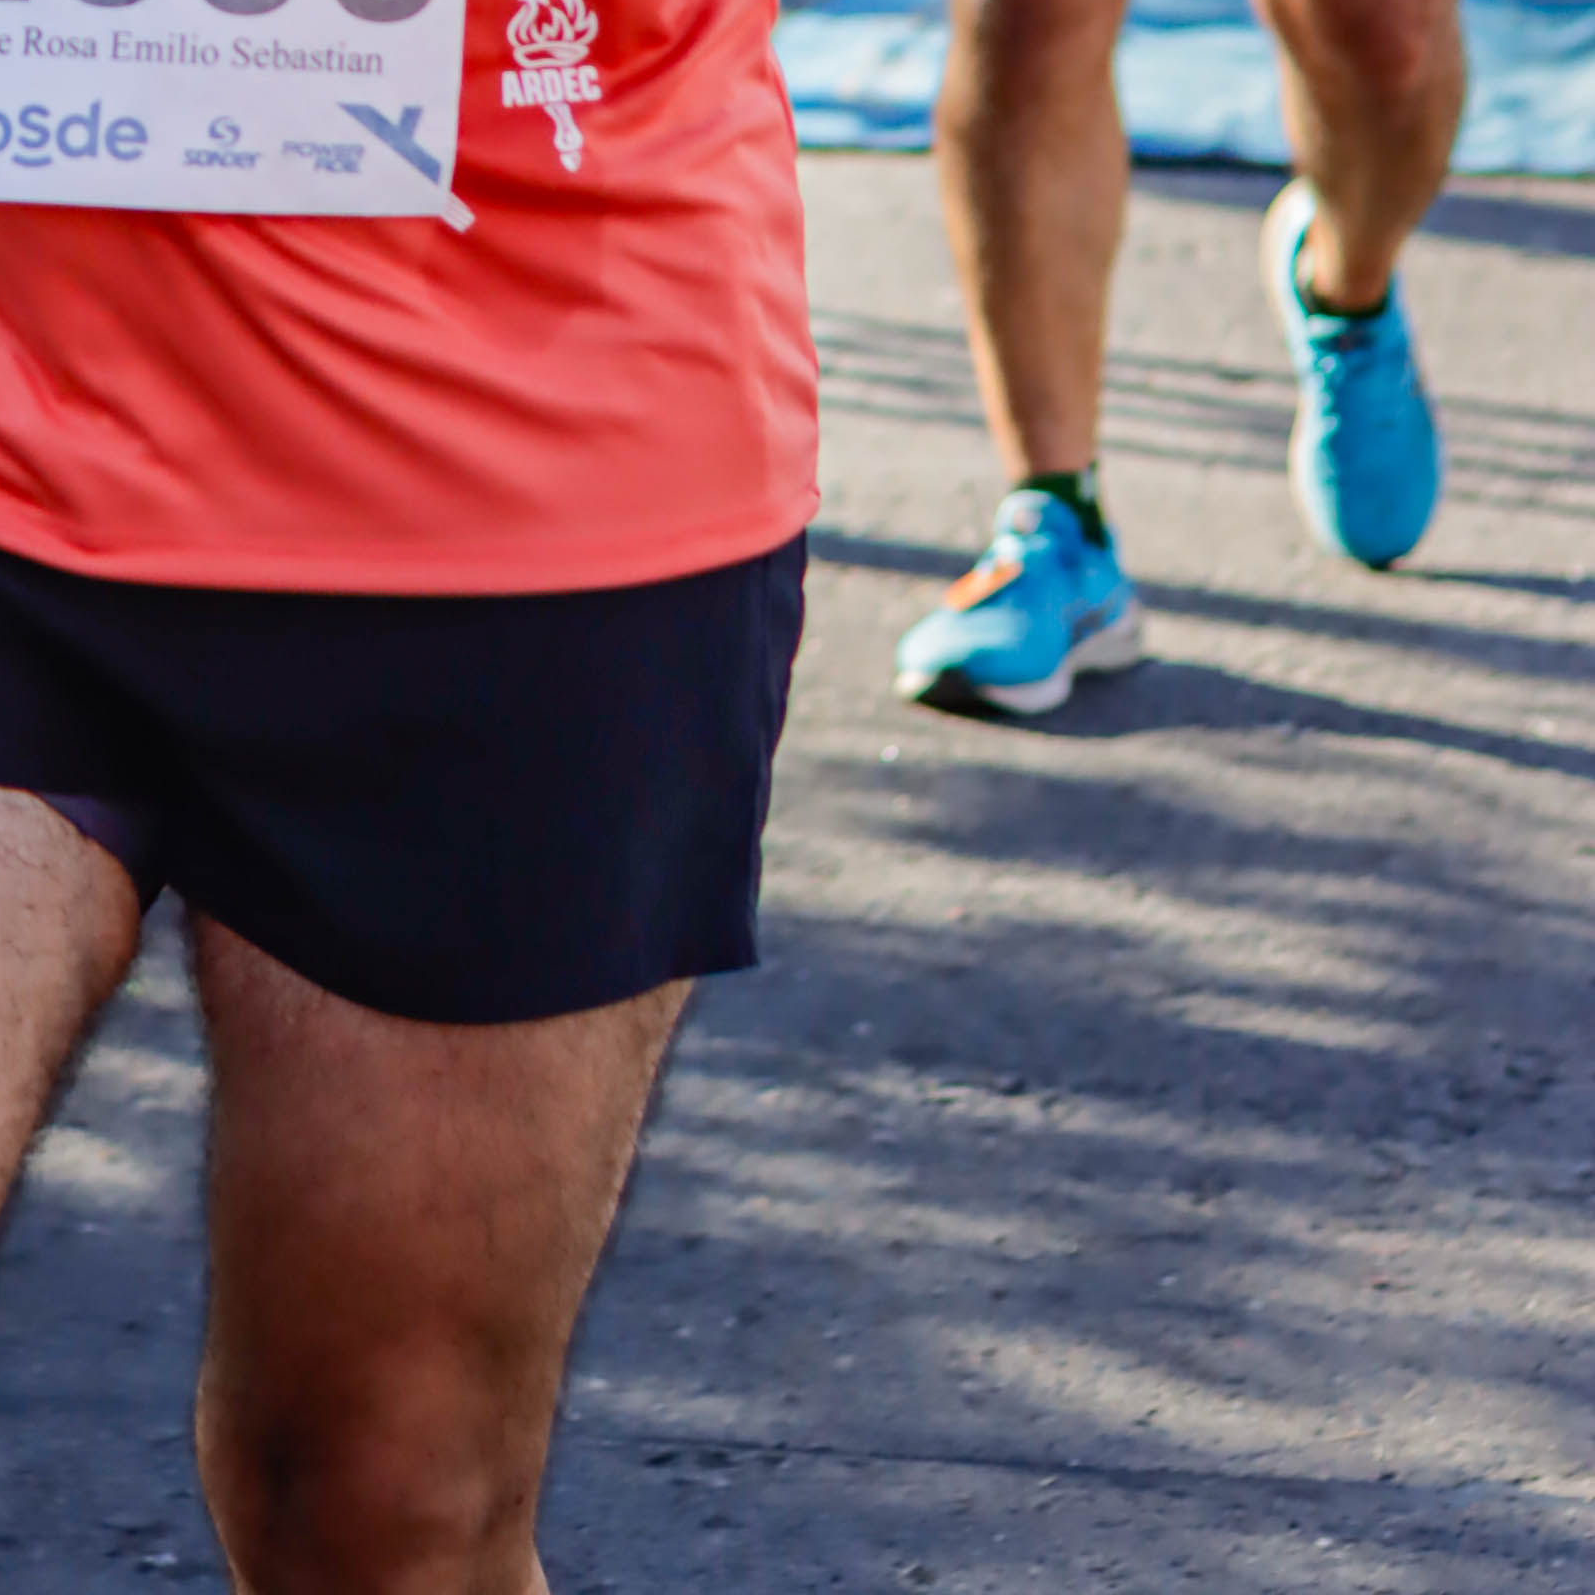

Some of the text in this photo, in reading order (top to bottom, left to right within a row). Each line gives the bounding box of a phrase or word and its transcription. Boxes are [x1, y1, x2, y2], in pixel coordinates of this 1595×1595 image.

[23, 25, 98, 60] Rosa
[110, 29, 220, 67] Emilio
[231, 37, 385, 76] Sebastian
[501, 65, 603, 108] ARDEC
